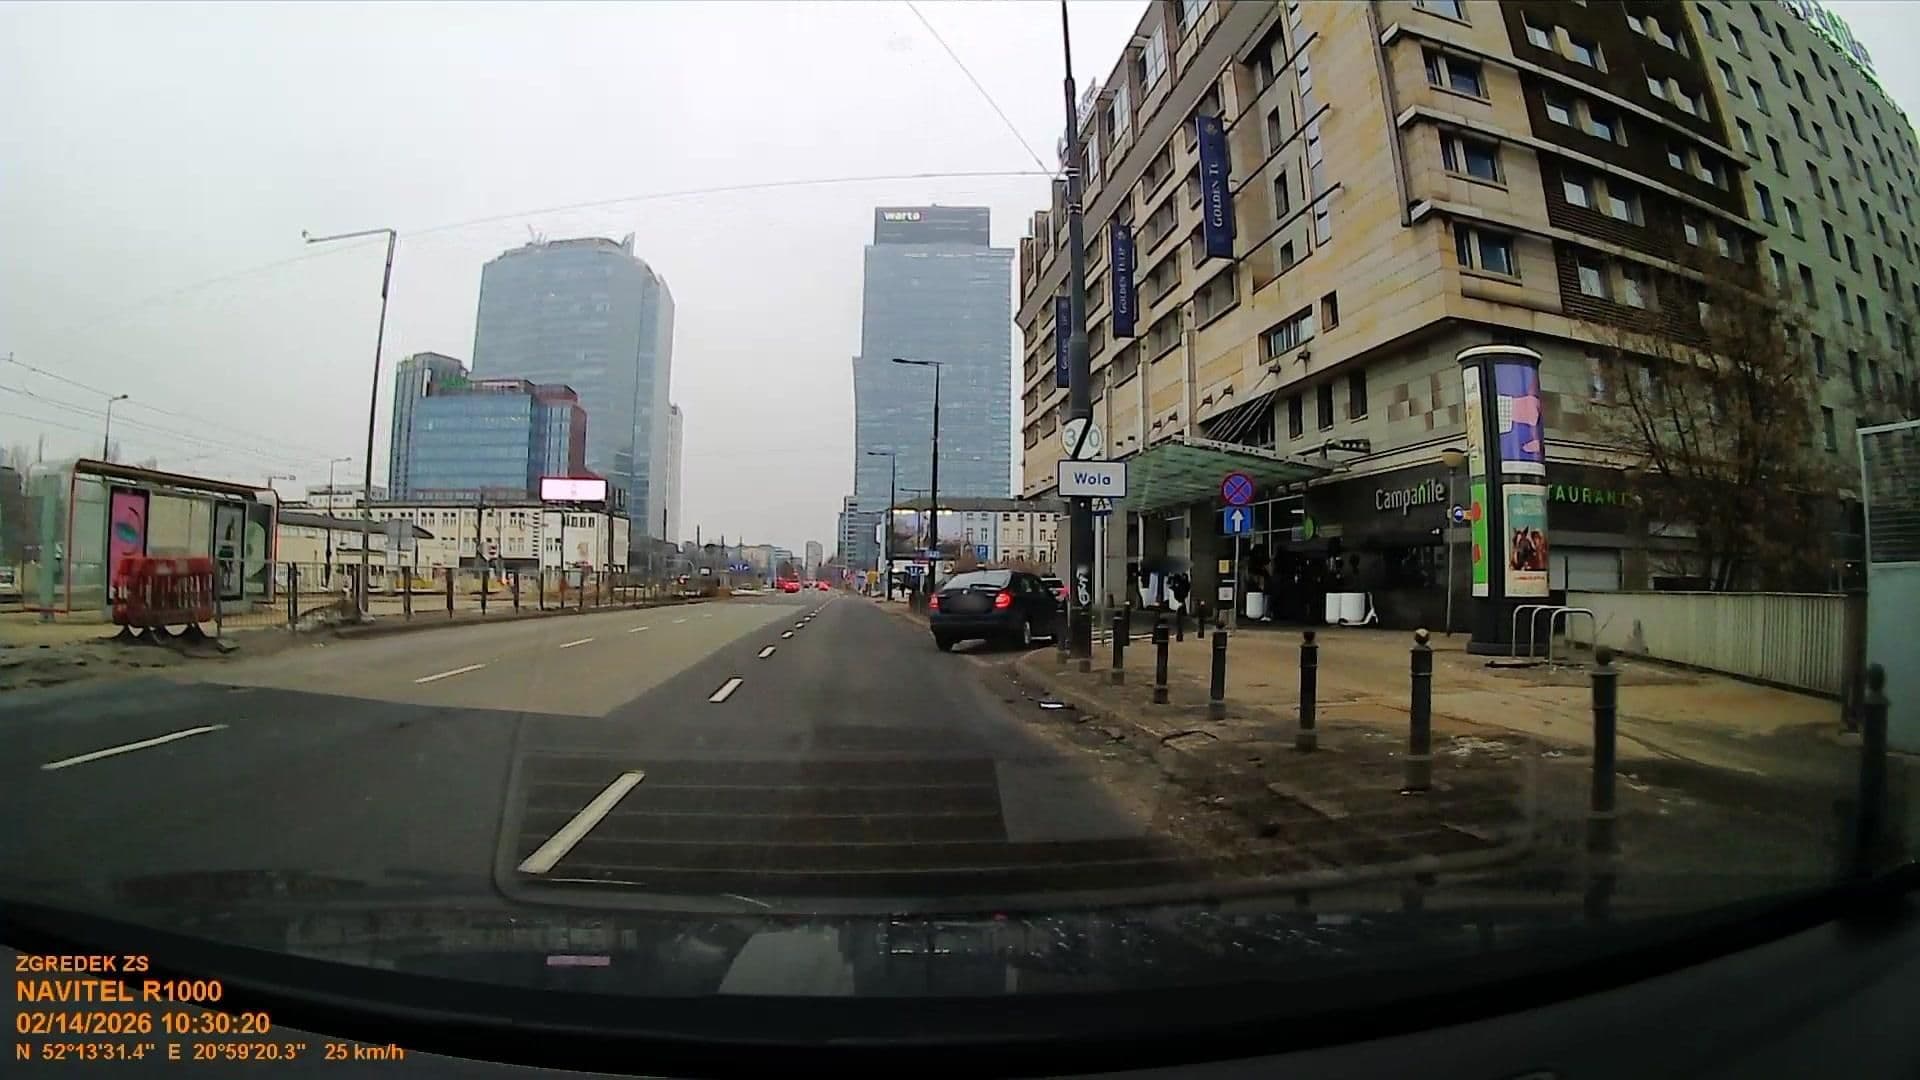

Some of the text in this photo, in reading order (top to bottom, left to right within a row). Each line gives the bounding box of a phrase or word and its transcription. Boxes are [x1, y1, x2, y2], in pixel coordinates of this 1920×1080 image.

[883, 211, 921, 222] warta
[1073, 471, 1112, 486] Wola
[1375, 477, 1446, 516] Campanile
